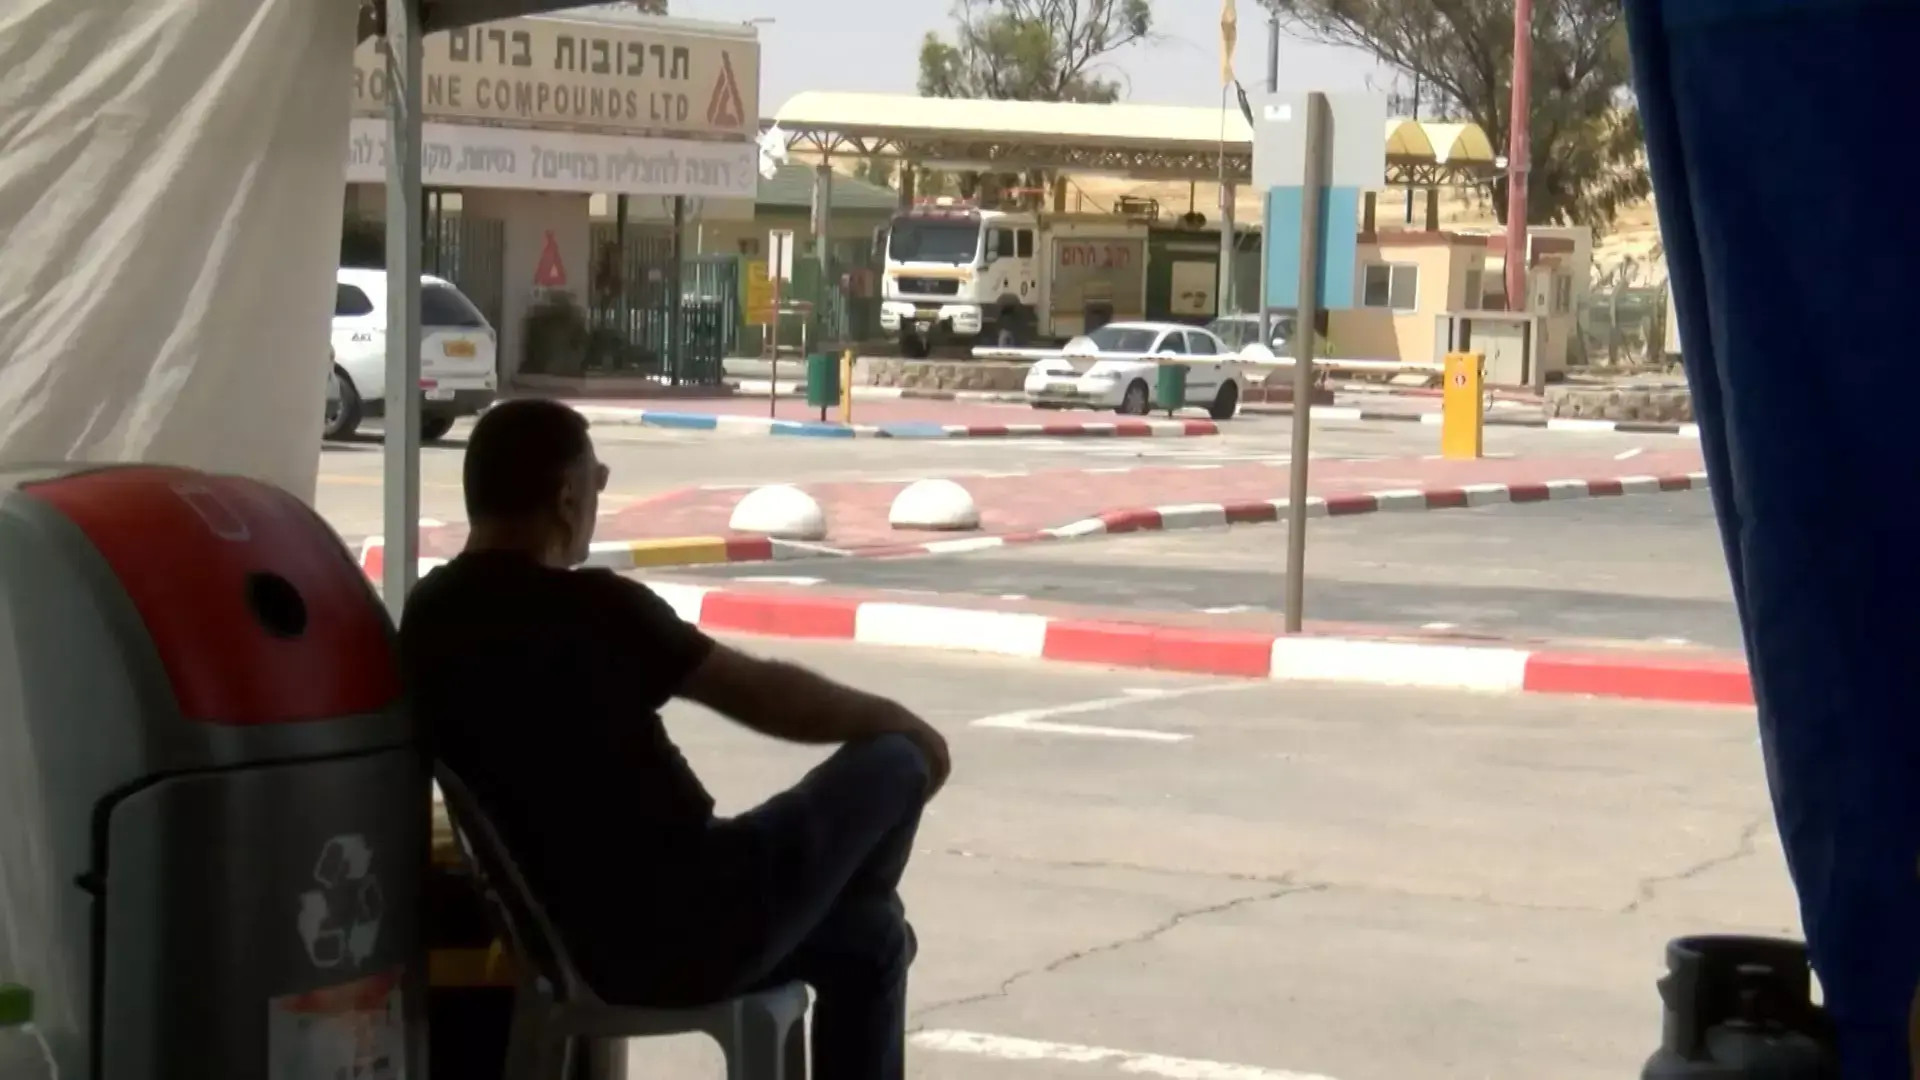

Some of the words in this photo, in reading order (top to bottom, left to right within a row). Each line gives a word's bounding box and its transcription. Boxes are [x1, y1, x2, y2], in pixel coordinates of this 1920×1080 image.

[448, 26, 533, 67] ברום
[554, 36, 690, 80] תרכובות
[475, 76, 638, 120] COMPOUNDS
[649, 92, 690, 123] LTD
